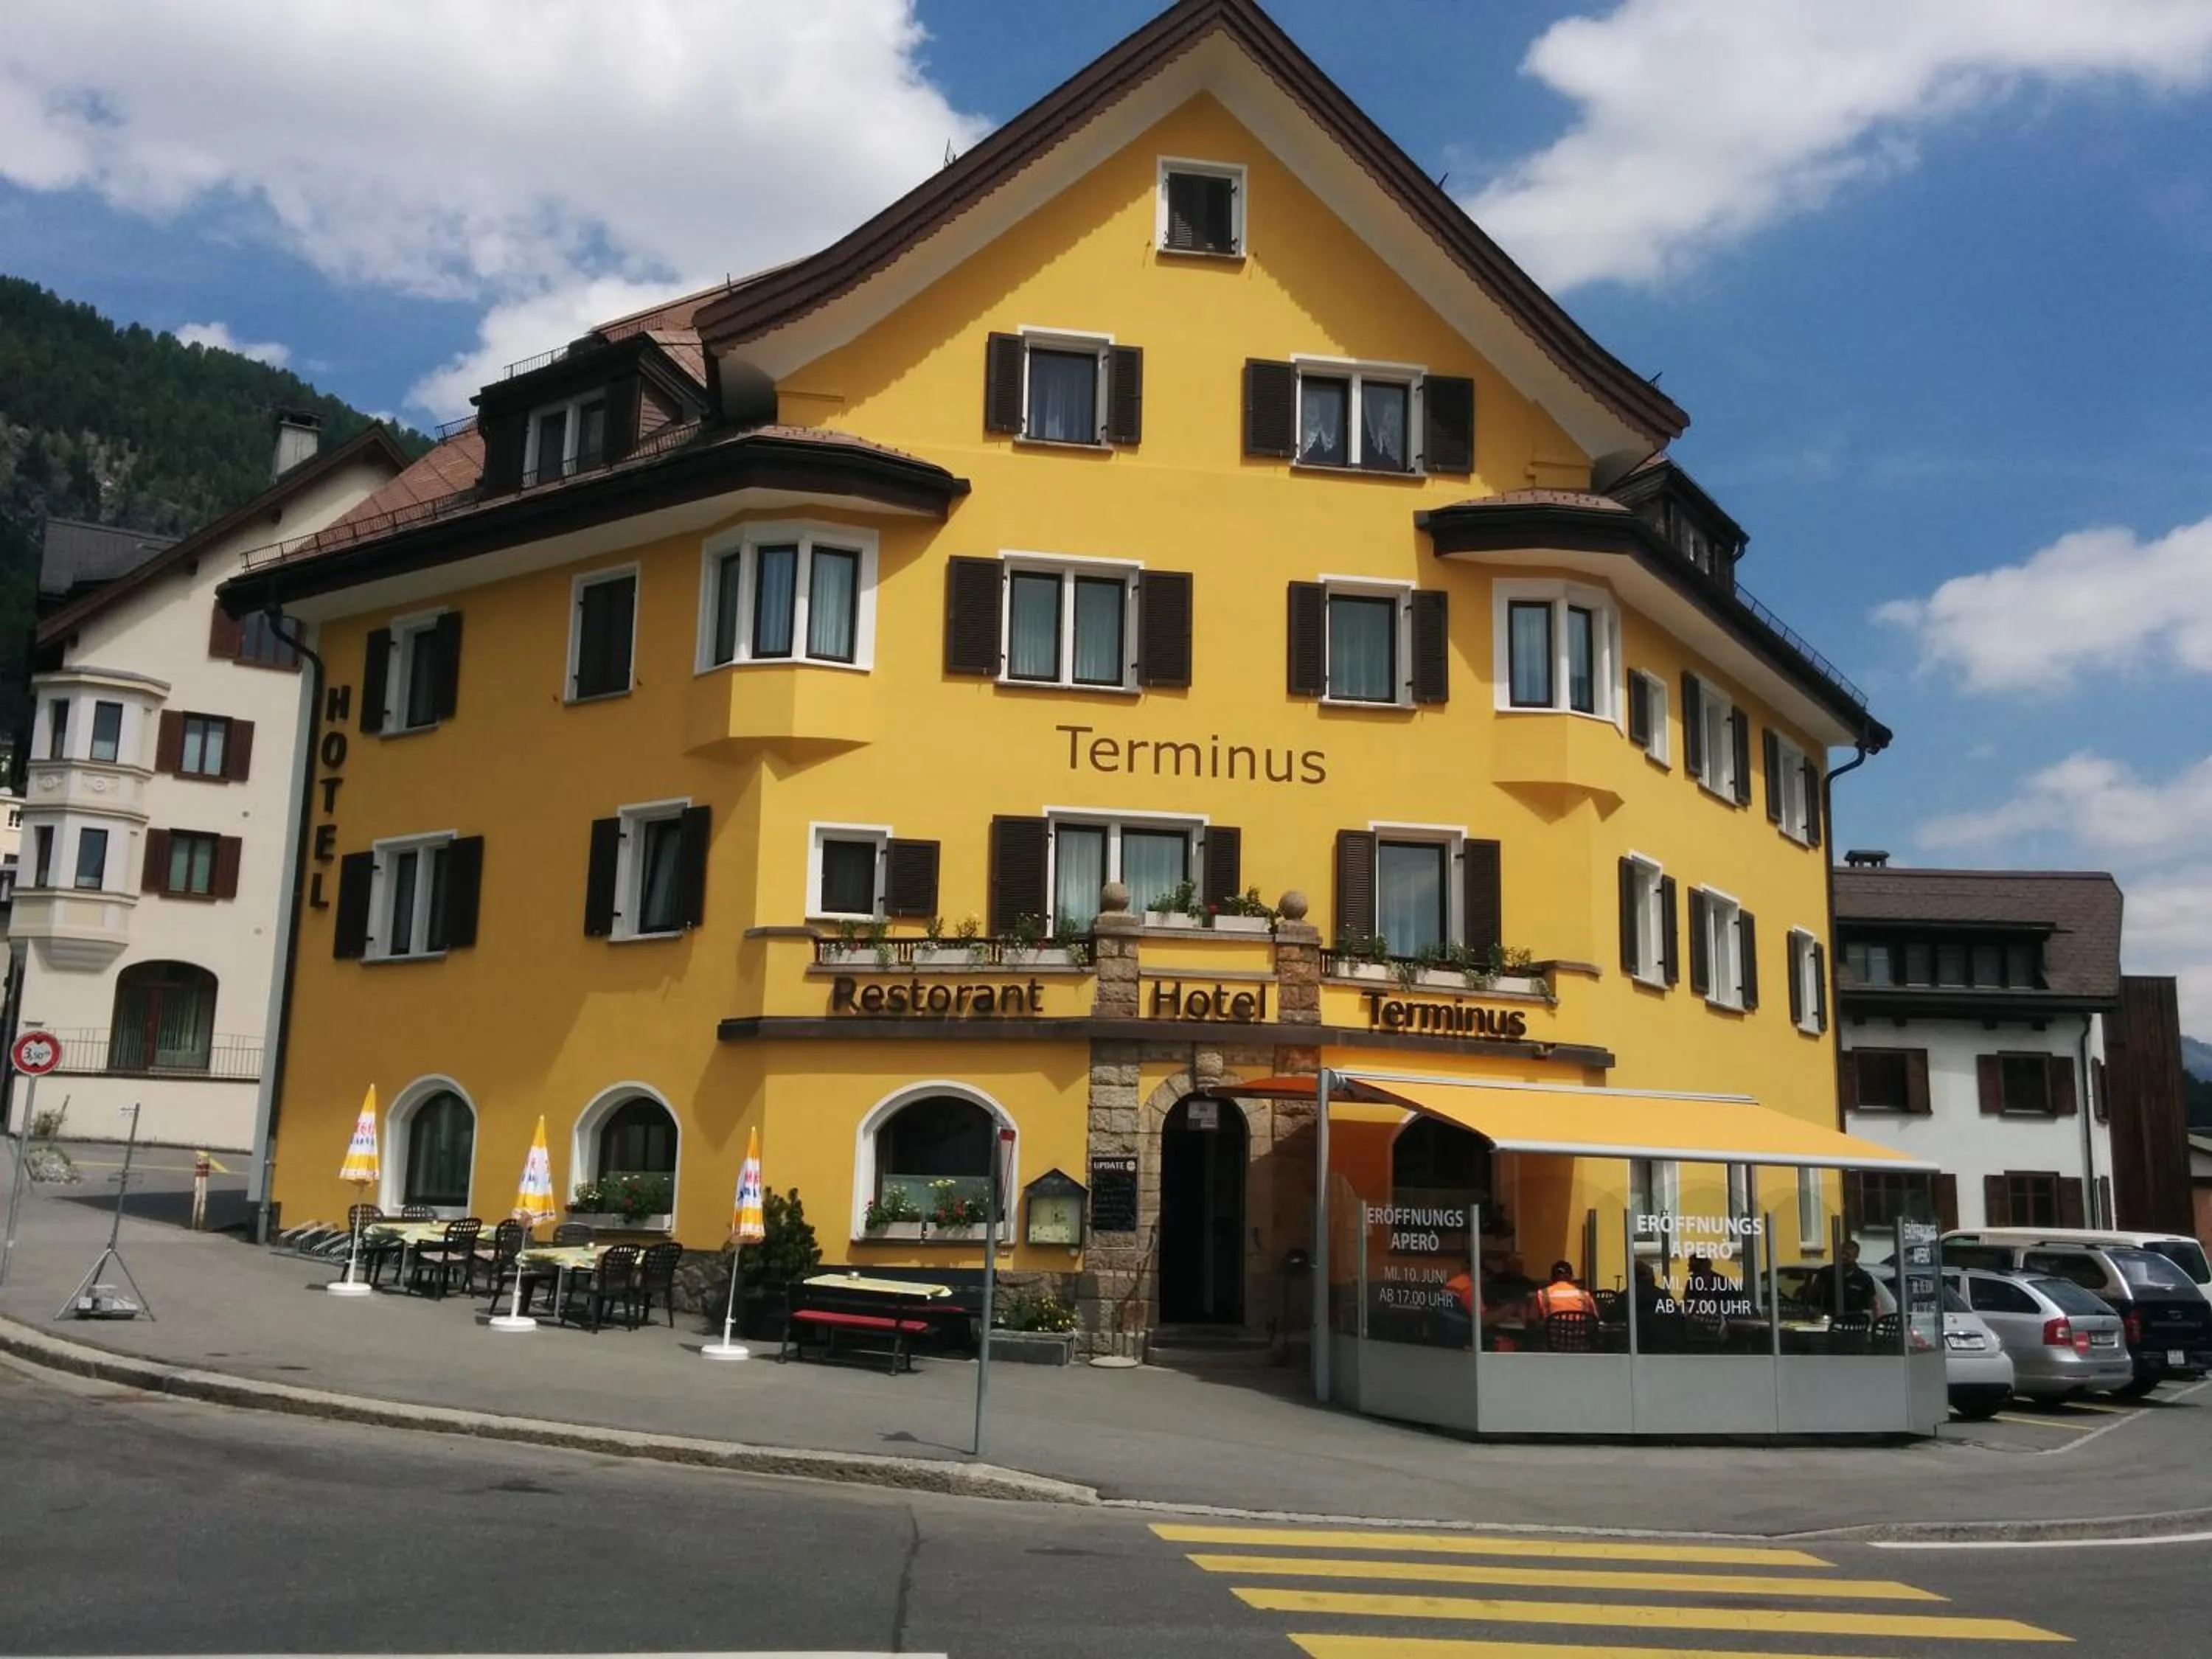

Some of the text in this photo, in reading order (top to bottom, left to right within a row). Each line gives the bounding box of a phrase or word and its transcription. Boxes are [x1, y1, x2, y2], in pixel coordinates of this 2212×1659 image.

[1055, 725, 1327, 785] Terminus
[310, 684, 351, 909] HOTEL
[832, 976, 1044, 1012] Restorant
[1154, 980, 1266, 1019] Hotel
[1361, 991, 1527, 1037] Terminus
[1093, 1161, 1124, 1171] UPDATE
[1367, 1204, 1464, 1227] ERÖFFNUNGS
[1636, 1211, 1763, 1235] ERÖFFNUNGS
[1384, 1266, 1447, 1284] MI. 10. JUNI
[1662, 1276, 1744, 1292] MI. 10. JUNI
[1379, 1287, 1454, 1308] AB 17.00 UHR
[1655, 1298, 1751, 1315] AB 17.00 UHR
